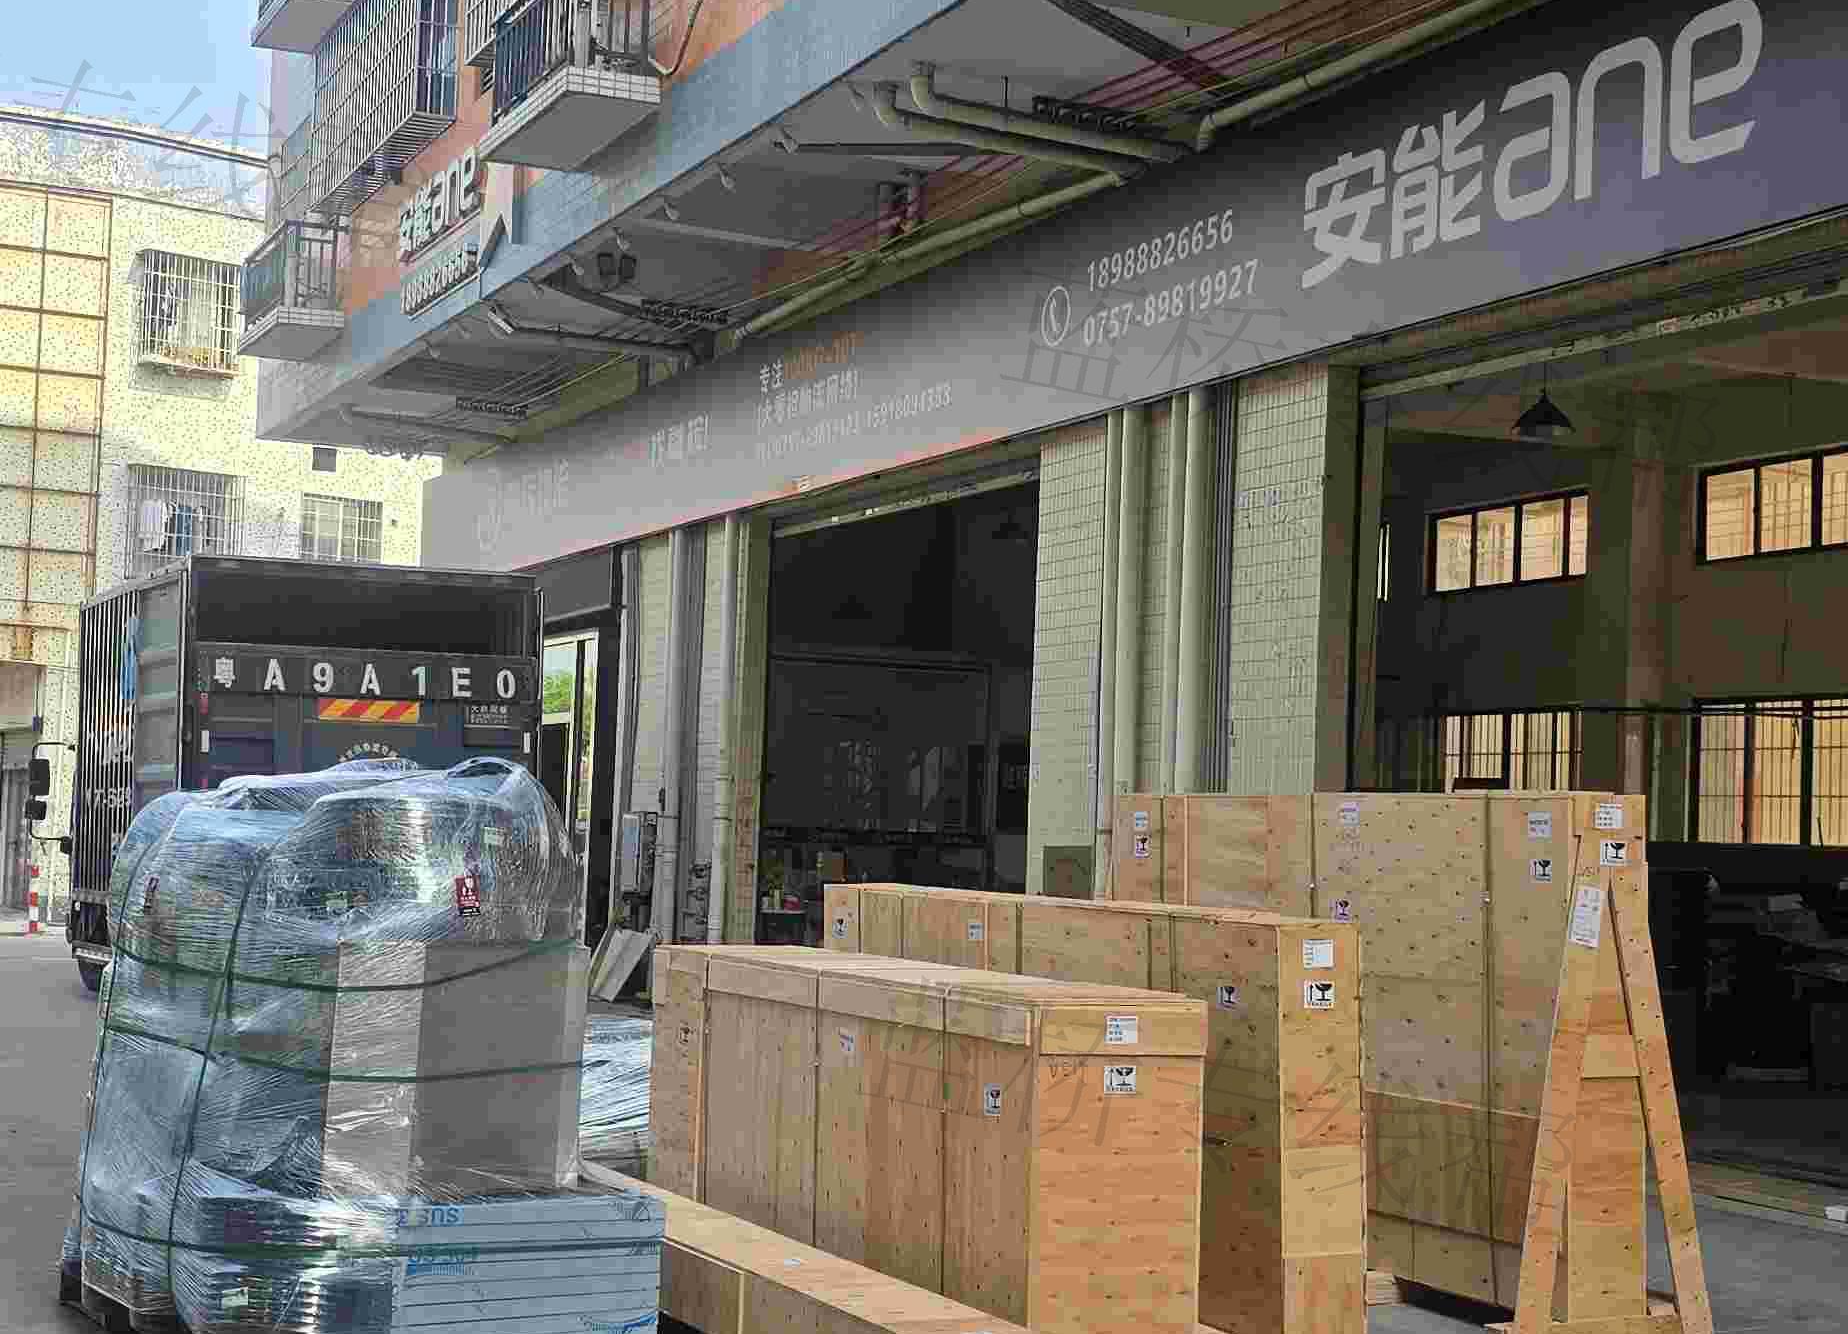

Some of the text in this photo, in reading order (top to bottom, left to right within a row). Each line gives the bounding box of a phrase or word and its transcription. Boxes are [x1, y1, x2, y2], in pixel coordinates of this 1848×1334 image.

[1087, 208, 1234, 292] 18988826656
[1083, 258, 1258, 348] 0757-89819927
[213, 657, 516, 698] 粤A9A1E0
